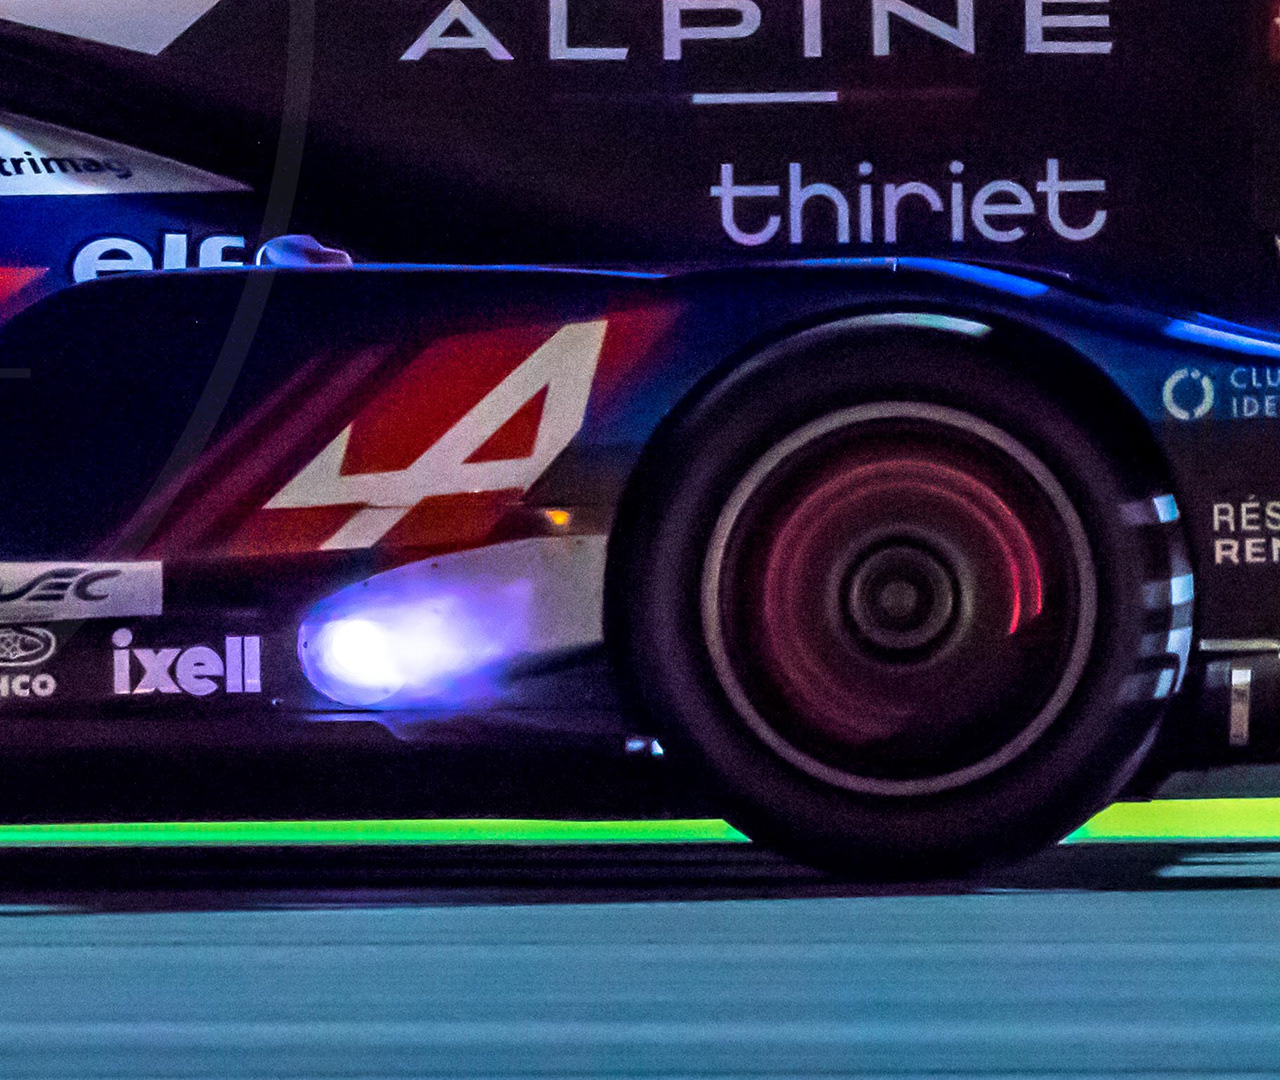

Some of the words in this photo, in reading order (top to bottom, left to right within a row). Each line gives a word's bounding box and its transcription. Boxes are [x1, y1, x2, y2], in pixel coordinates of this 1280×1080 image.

[711, 158, 1107, 247] thiriet
[74, 234, 244, 283] elf
[112, 628, 261, 696] ixell
